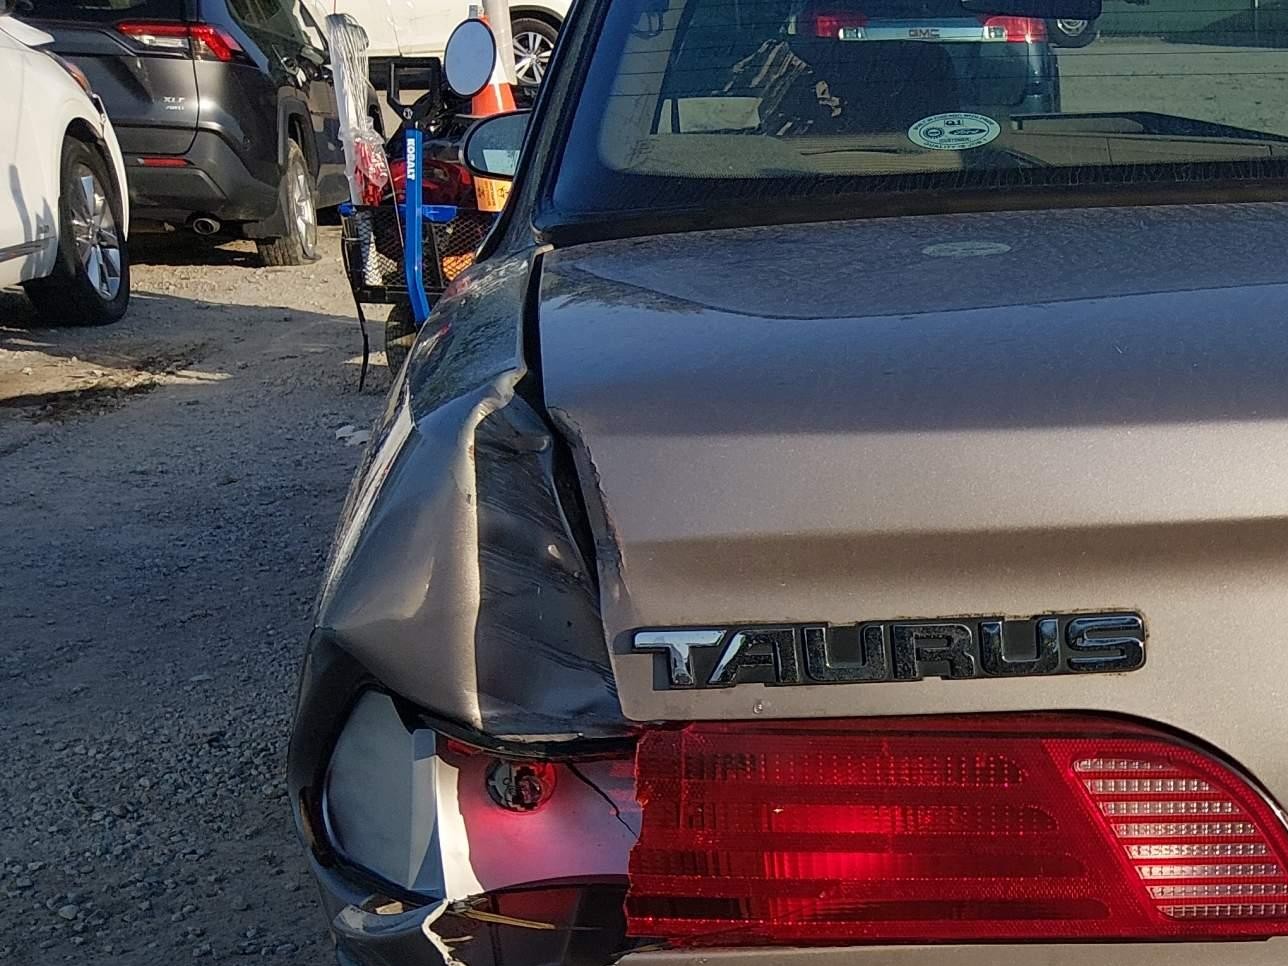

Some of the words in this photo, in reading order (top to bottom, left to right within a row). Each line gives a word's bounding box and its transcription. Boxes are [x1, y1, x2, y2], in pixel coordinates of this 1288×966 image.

[908, 28, 940, 38] GMC
[406, 138, 416, 180] KOBALT
[633, 615, 1147, 688] TAURUS
